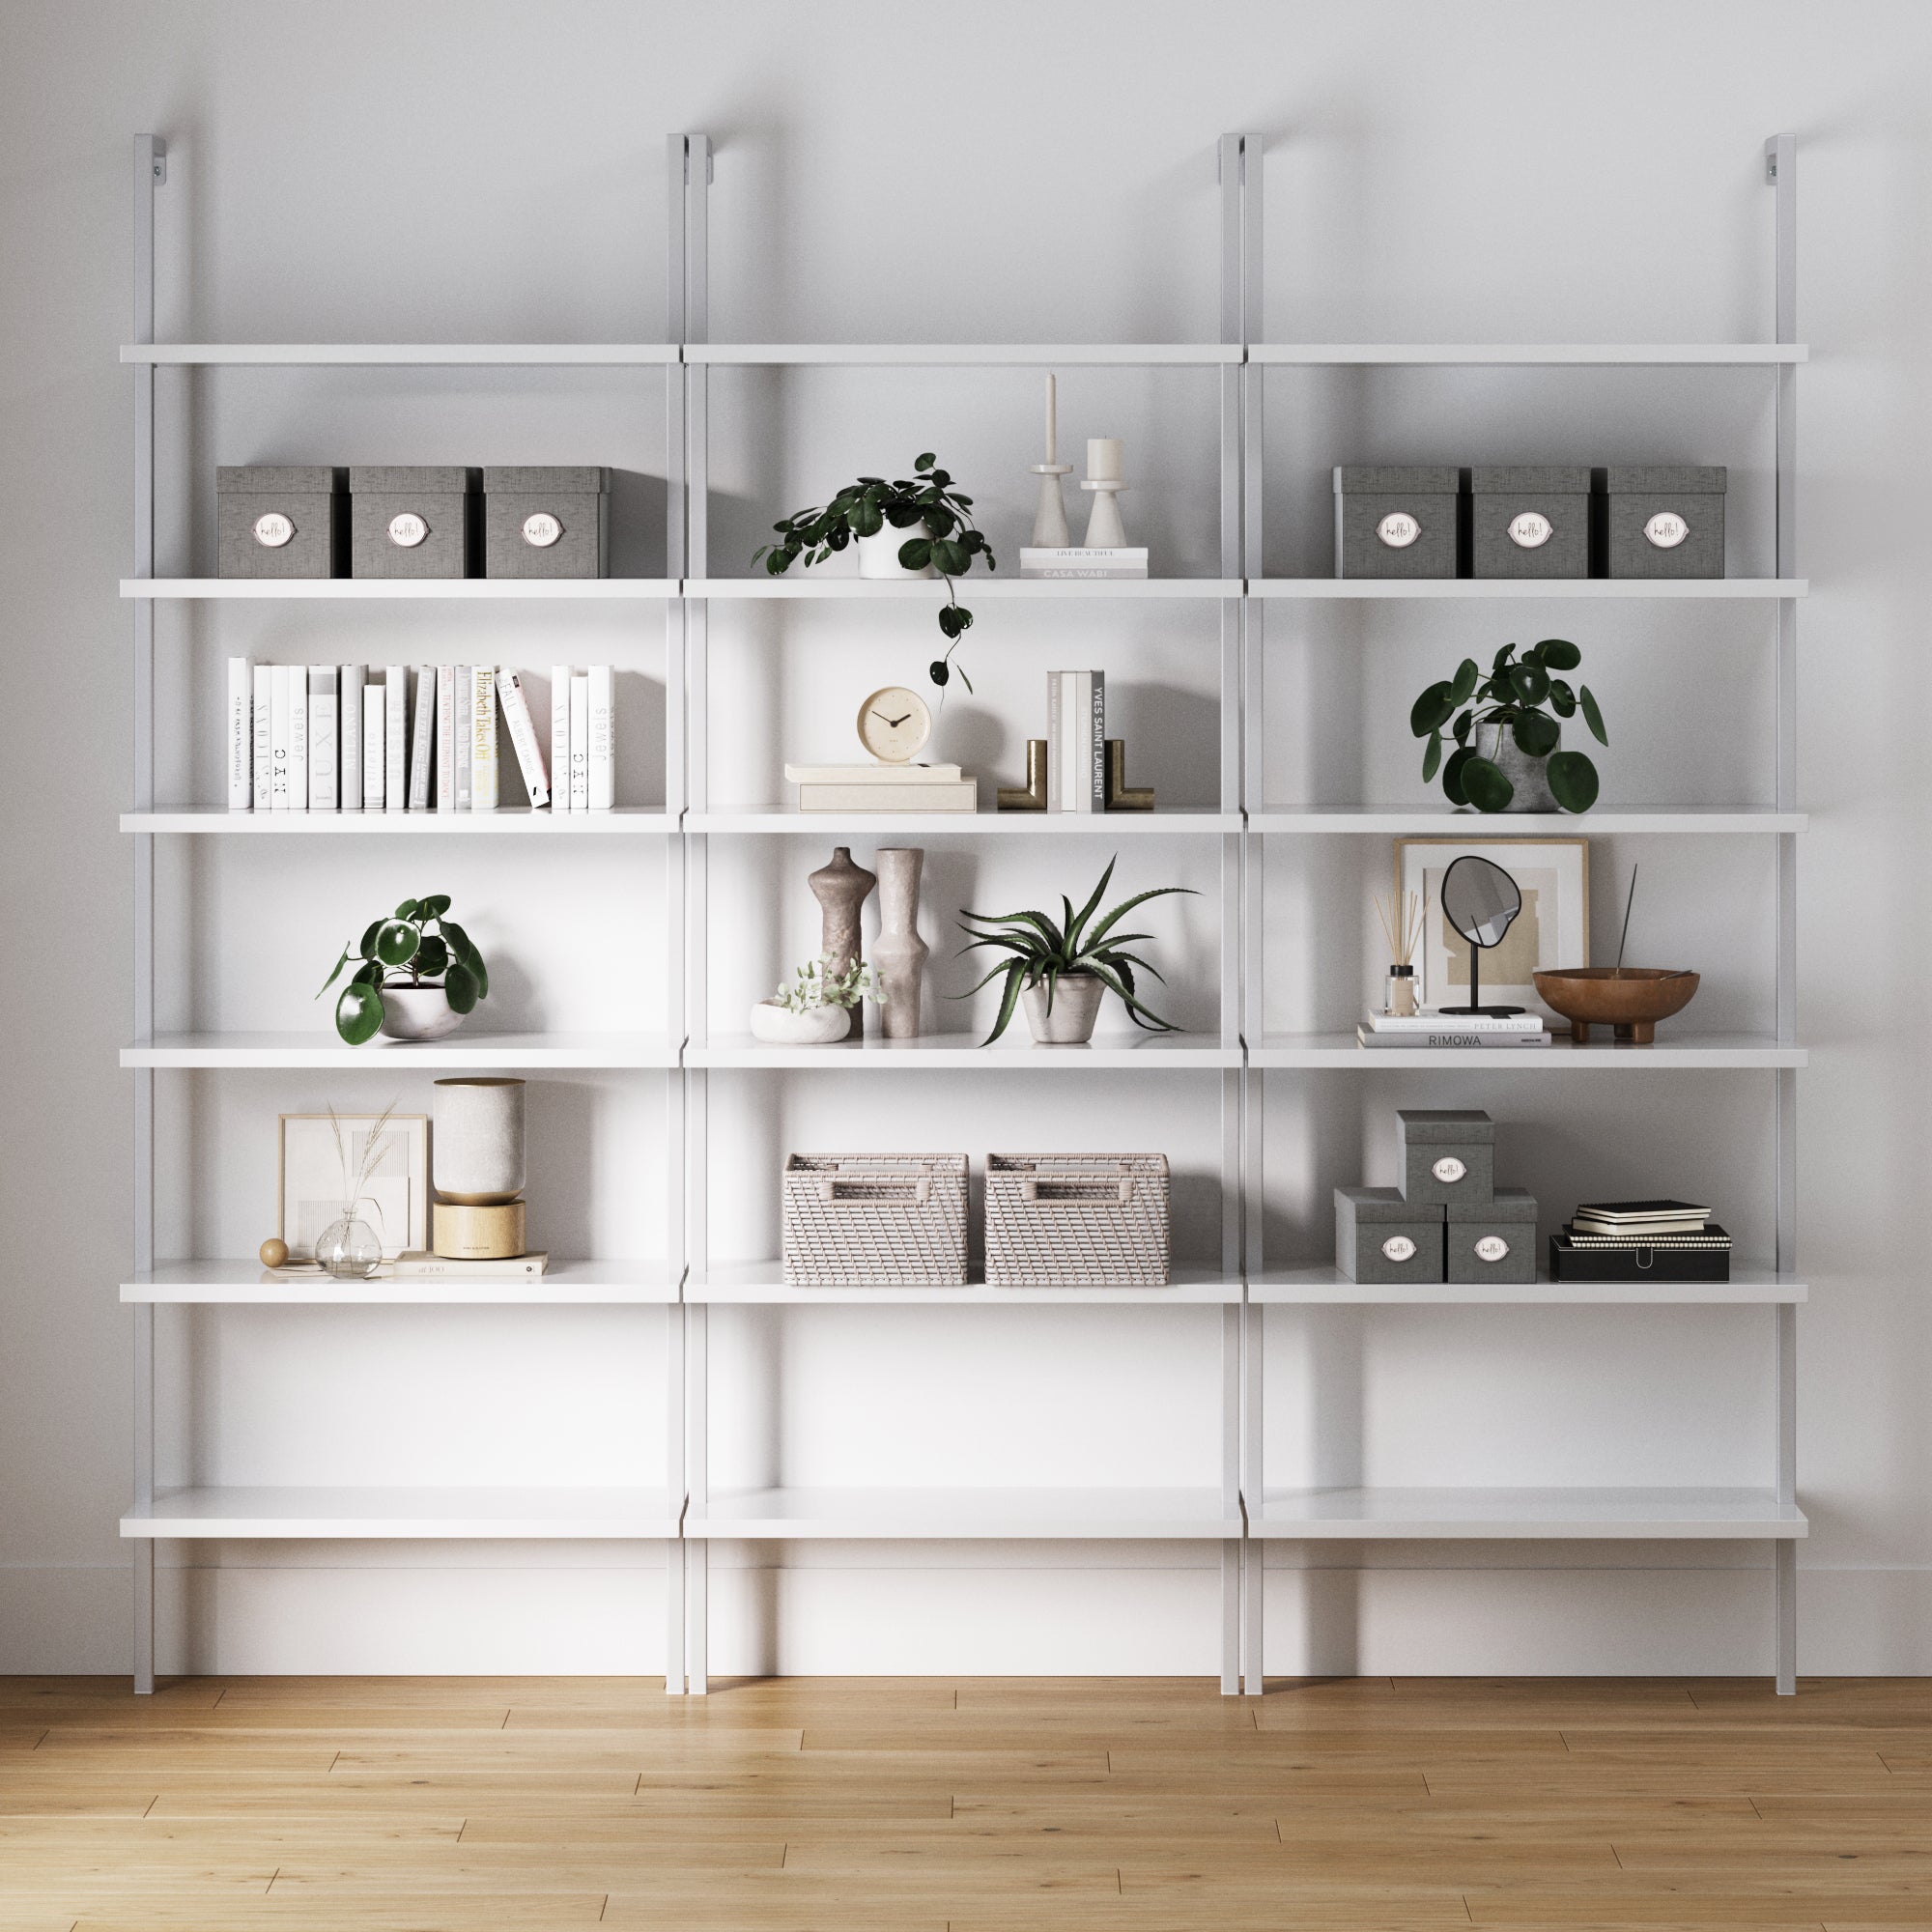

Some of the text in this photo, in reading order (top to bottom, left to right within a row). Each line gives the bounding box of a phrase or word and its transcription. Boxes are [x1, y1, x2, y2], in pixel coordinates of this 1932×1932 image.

[260, 523, 285, 539] hello!
[394, 523, 419, 539] hello!
[527, 523, 554, 539] hello!
[1385, 522, 1410, 538] hello!
[1518, 522, 1543, 538] hello!
[1654, 522, 1679, 538] hello!
[476, 670, 493, 716] Elizabeth
[293, 707, 304, 761] Jewels
[345, 703, 356, 770] MILANO
[475, 716, 492, 742] Takes
[592, 707, 607, 761] Jewels
[475, 743, 491, 760] Off
[1094, 687, 1103, 800] YVES SAINT LAURENT
[315, 704, 333, 803] LUXE
[274, 749, 286, 793] NYC
[1429, 1036, 1482, 1046] RIMOWA
[1439, 1164, 1459, 1177] hello!
[1388, 1242, 1408, 1256] hello!
[1481, 1242, 1502, 1256] hello!
